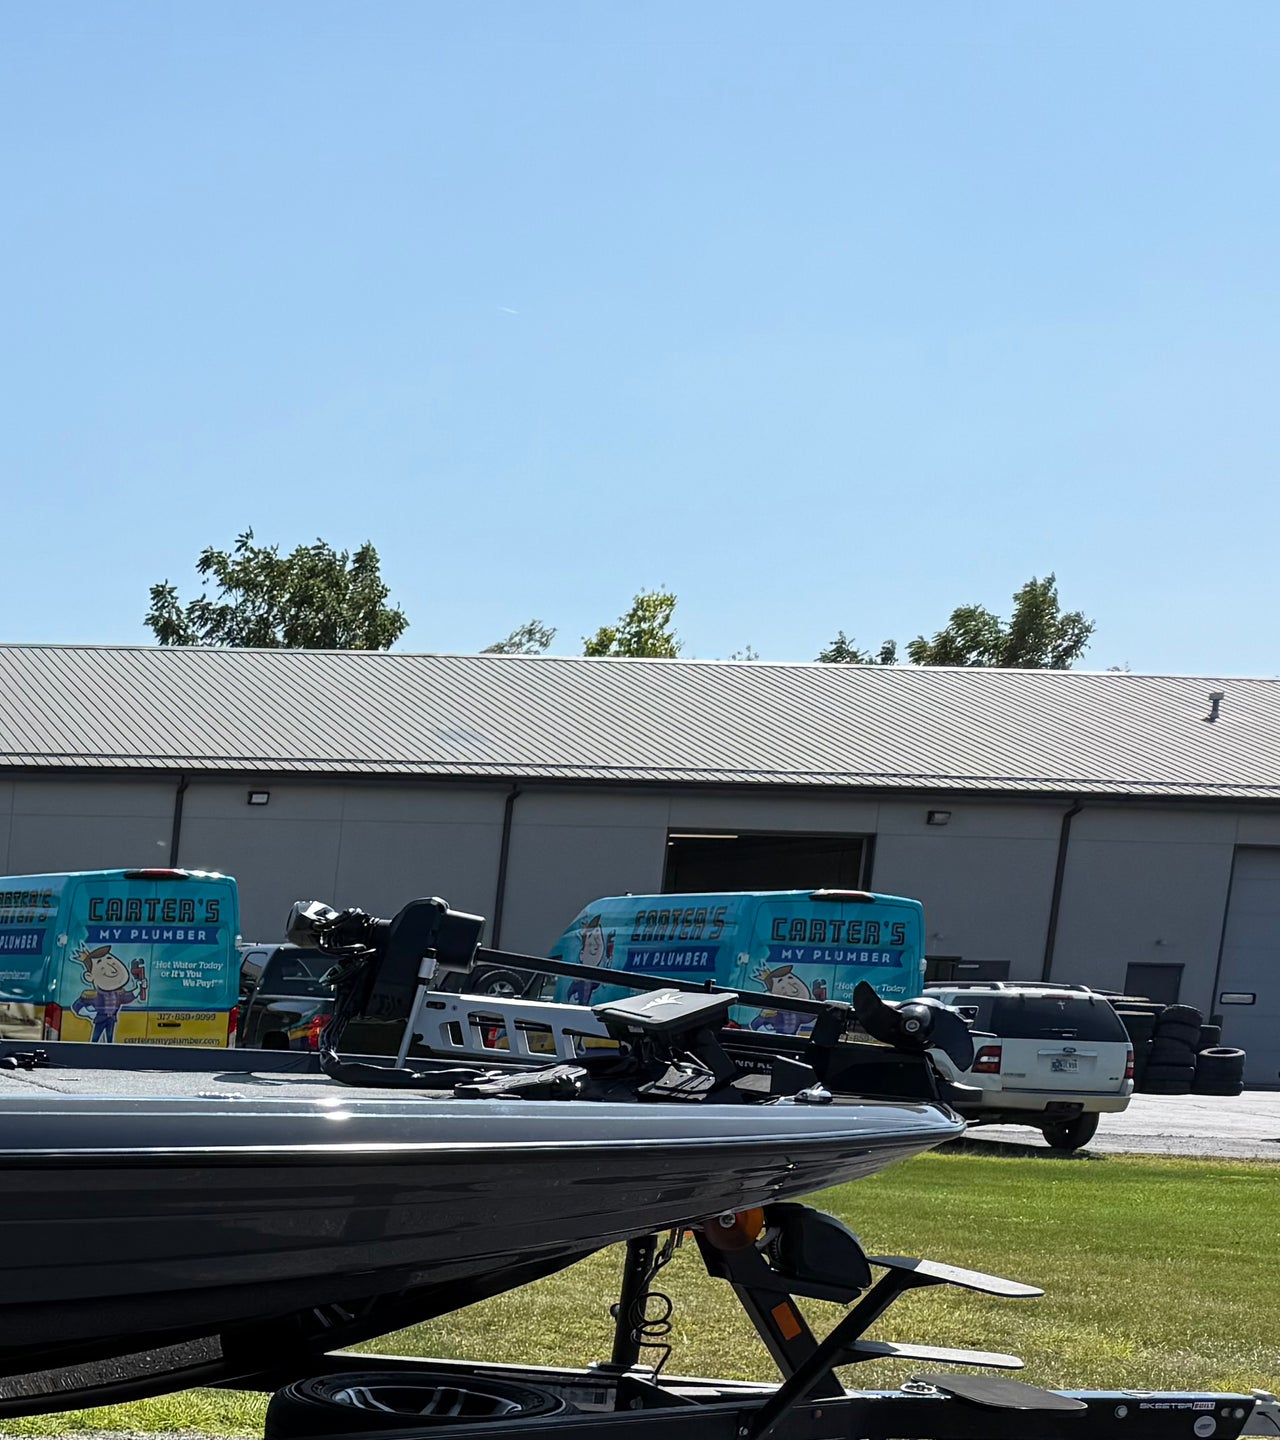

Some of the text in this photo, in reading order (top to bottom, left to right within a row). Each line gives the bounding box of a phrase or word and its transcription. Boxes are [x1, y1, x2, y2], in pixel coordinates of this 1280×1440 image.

[88, 898, 220, 923] CARTER'S
[99, 929, 207, 941] MY PLUMBER
[771, 917, 906, 946] CARTER'S
[632, 951, 709, 967] MY PLUMBER
[781, 949, 890, 964] MY PLUMBER
[173, 961, 197, 969] Water
[198, 961, 224, 971] Today
[186, 970, 203, 978] You
